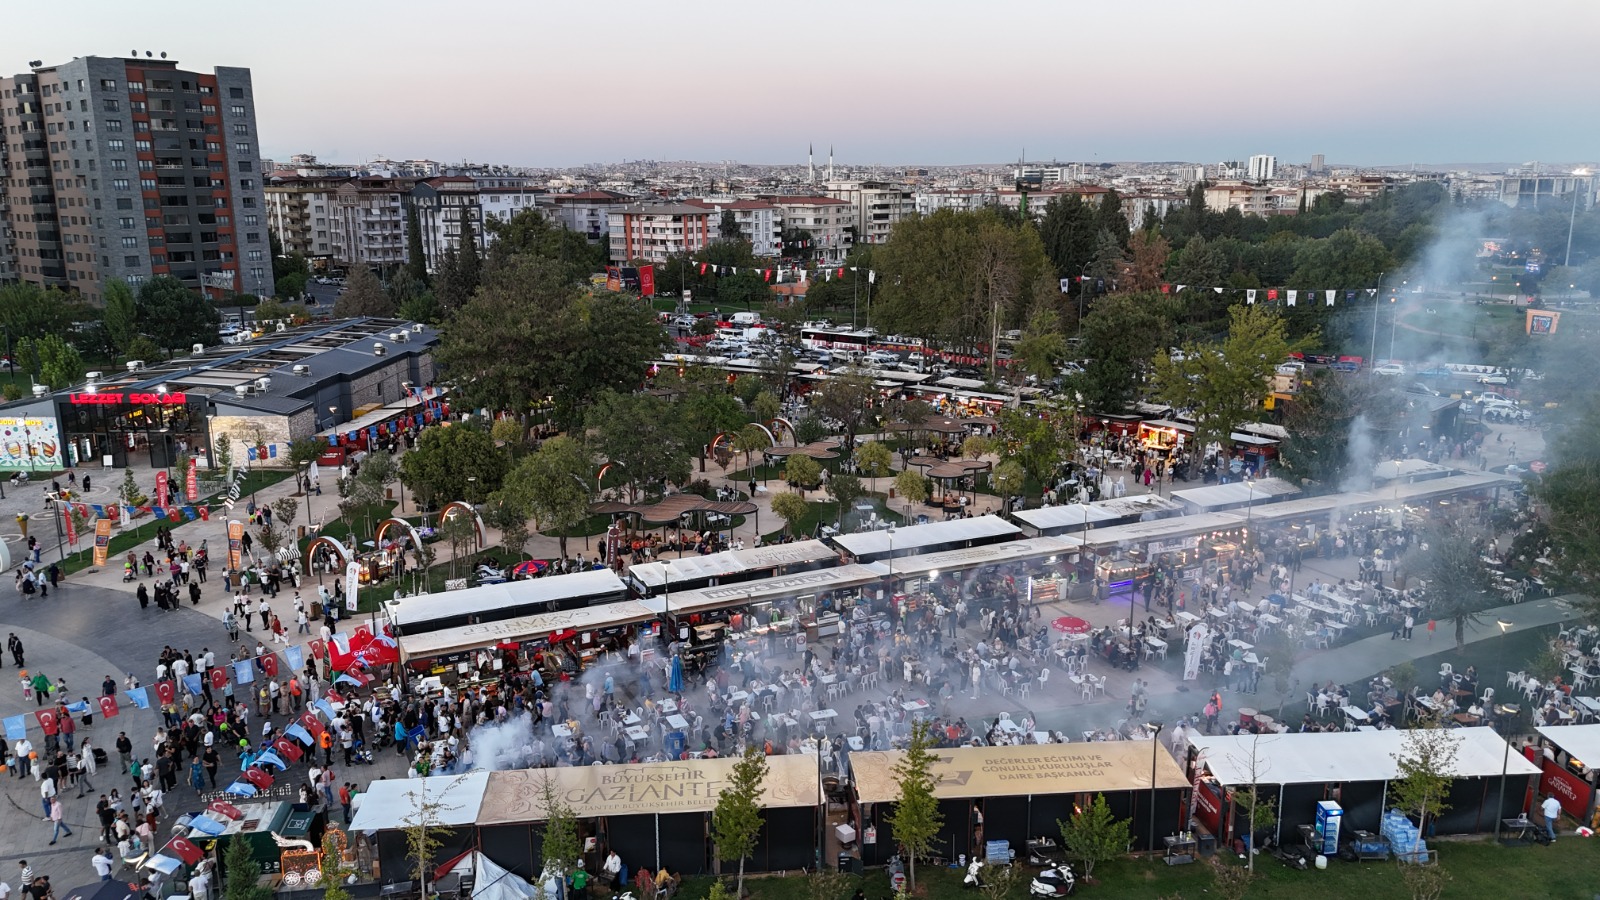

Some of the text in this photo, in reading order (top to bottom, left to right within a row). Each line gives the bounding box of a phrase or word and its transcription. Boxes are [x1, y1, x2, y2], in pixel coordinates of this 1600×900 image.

[69, 393, 124, 405] LEZZET
[984, 756, 1042, 766] DEĞERLER
[1038, 761, 1113, 771] KURULUŞLAR
[1036, 769, 1105, 780] BAŞKANLIĞI
[564, 780, 736, 805] GAZİANTE
